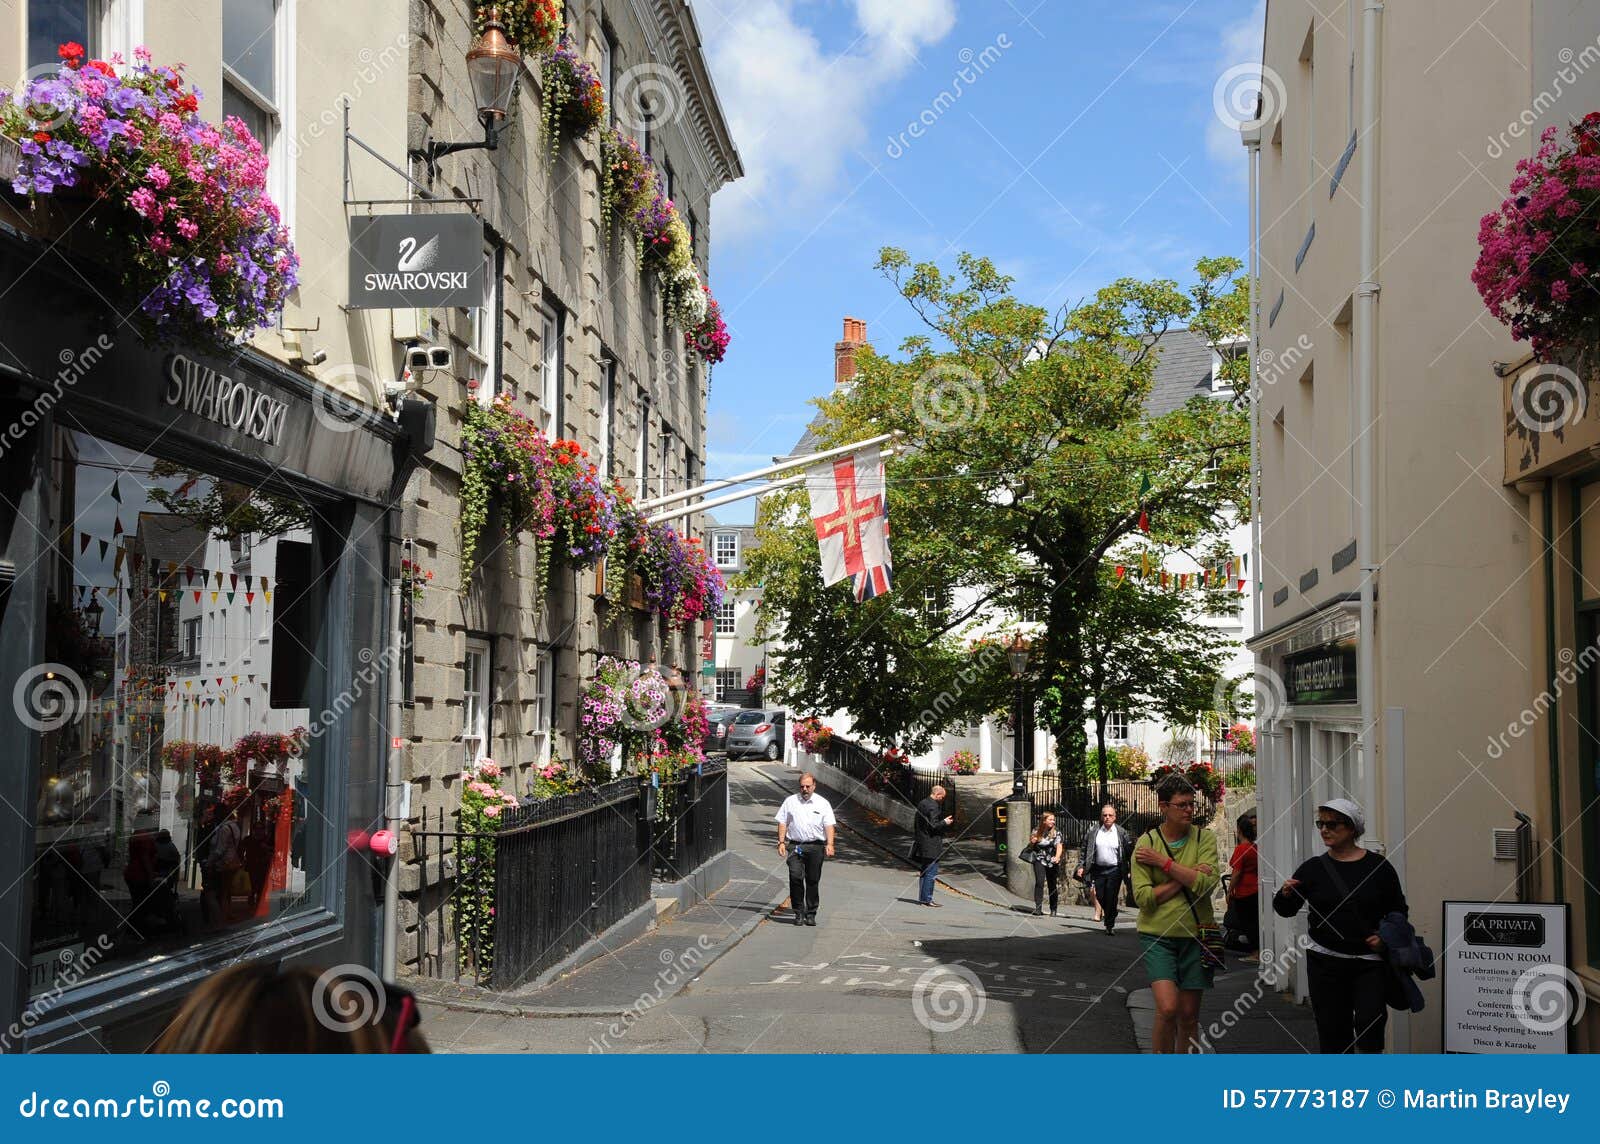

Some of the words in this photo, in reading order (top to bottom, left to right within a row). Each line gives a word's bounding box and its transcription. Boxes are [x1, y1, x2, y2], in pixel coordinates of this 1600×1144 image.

[364, 271, 468, 291] SWAROVSKI
[166, 353, 288, 448] SWAROVSKI
[1472, 919, 1486, 929] LA
[1489, 919, 1537, 931] PRIVATA
[1458, 951, 1514, 961] FUNCTION
[1518, 953, 1552, 963] ROOM
[1463, 966, 1509, 976] Celebrations
[1510, 968, 1517, 976] &
[1478, 987, 1504, 996] Private
[1506, 987, 1531, 997] dining
[1478, 1001, 1522, 1010] Conferences
[1467, 1009, 1504, 1019] Corporate
[1505, 1012, 1543, 1021] Functions
[1458, 1022, 1491, 1032] Televised
[1493, 1024, 1526, 1035] Sporting
[1473, 1038, 1494, 1047] Disco
[1496, 1040, 1502, 1048] &
[1504, 1041, 1537, 1050] Karaoke
